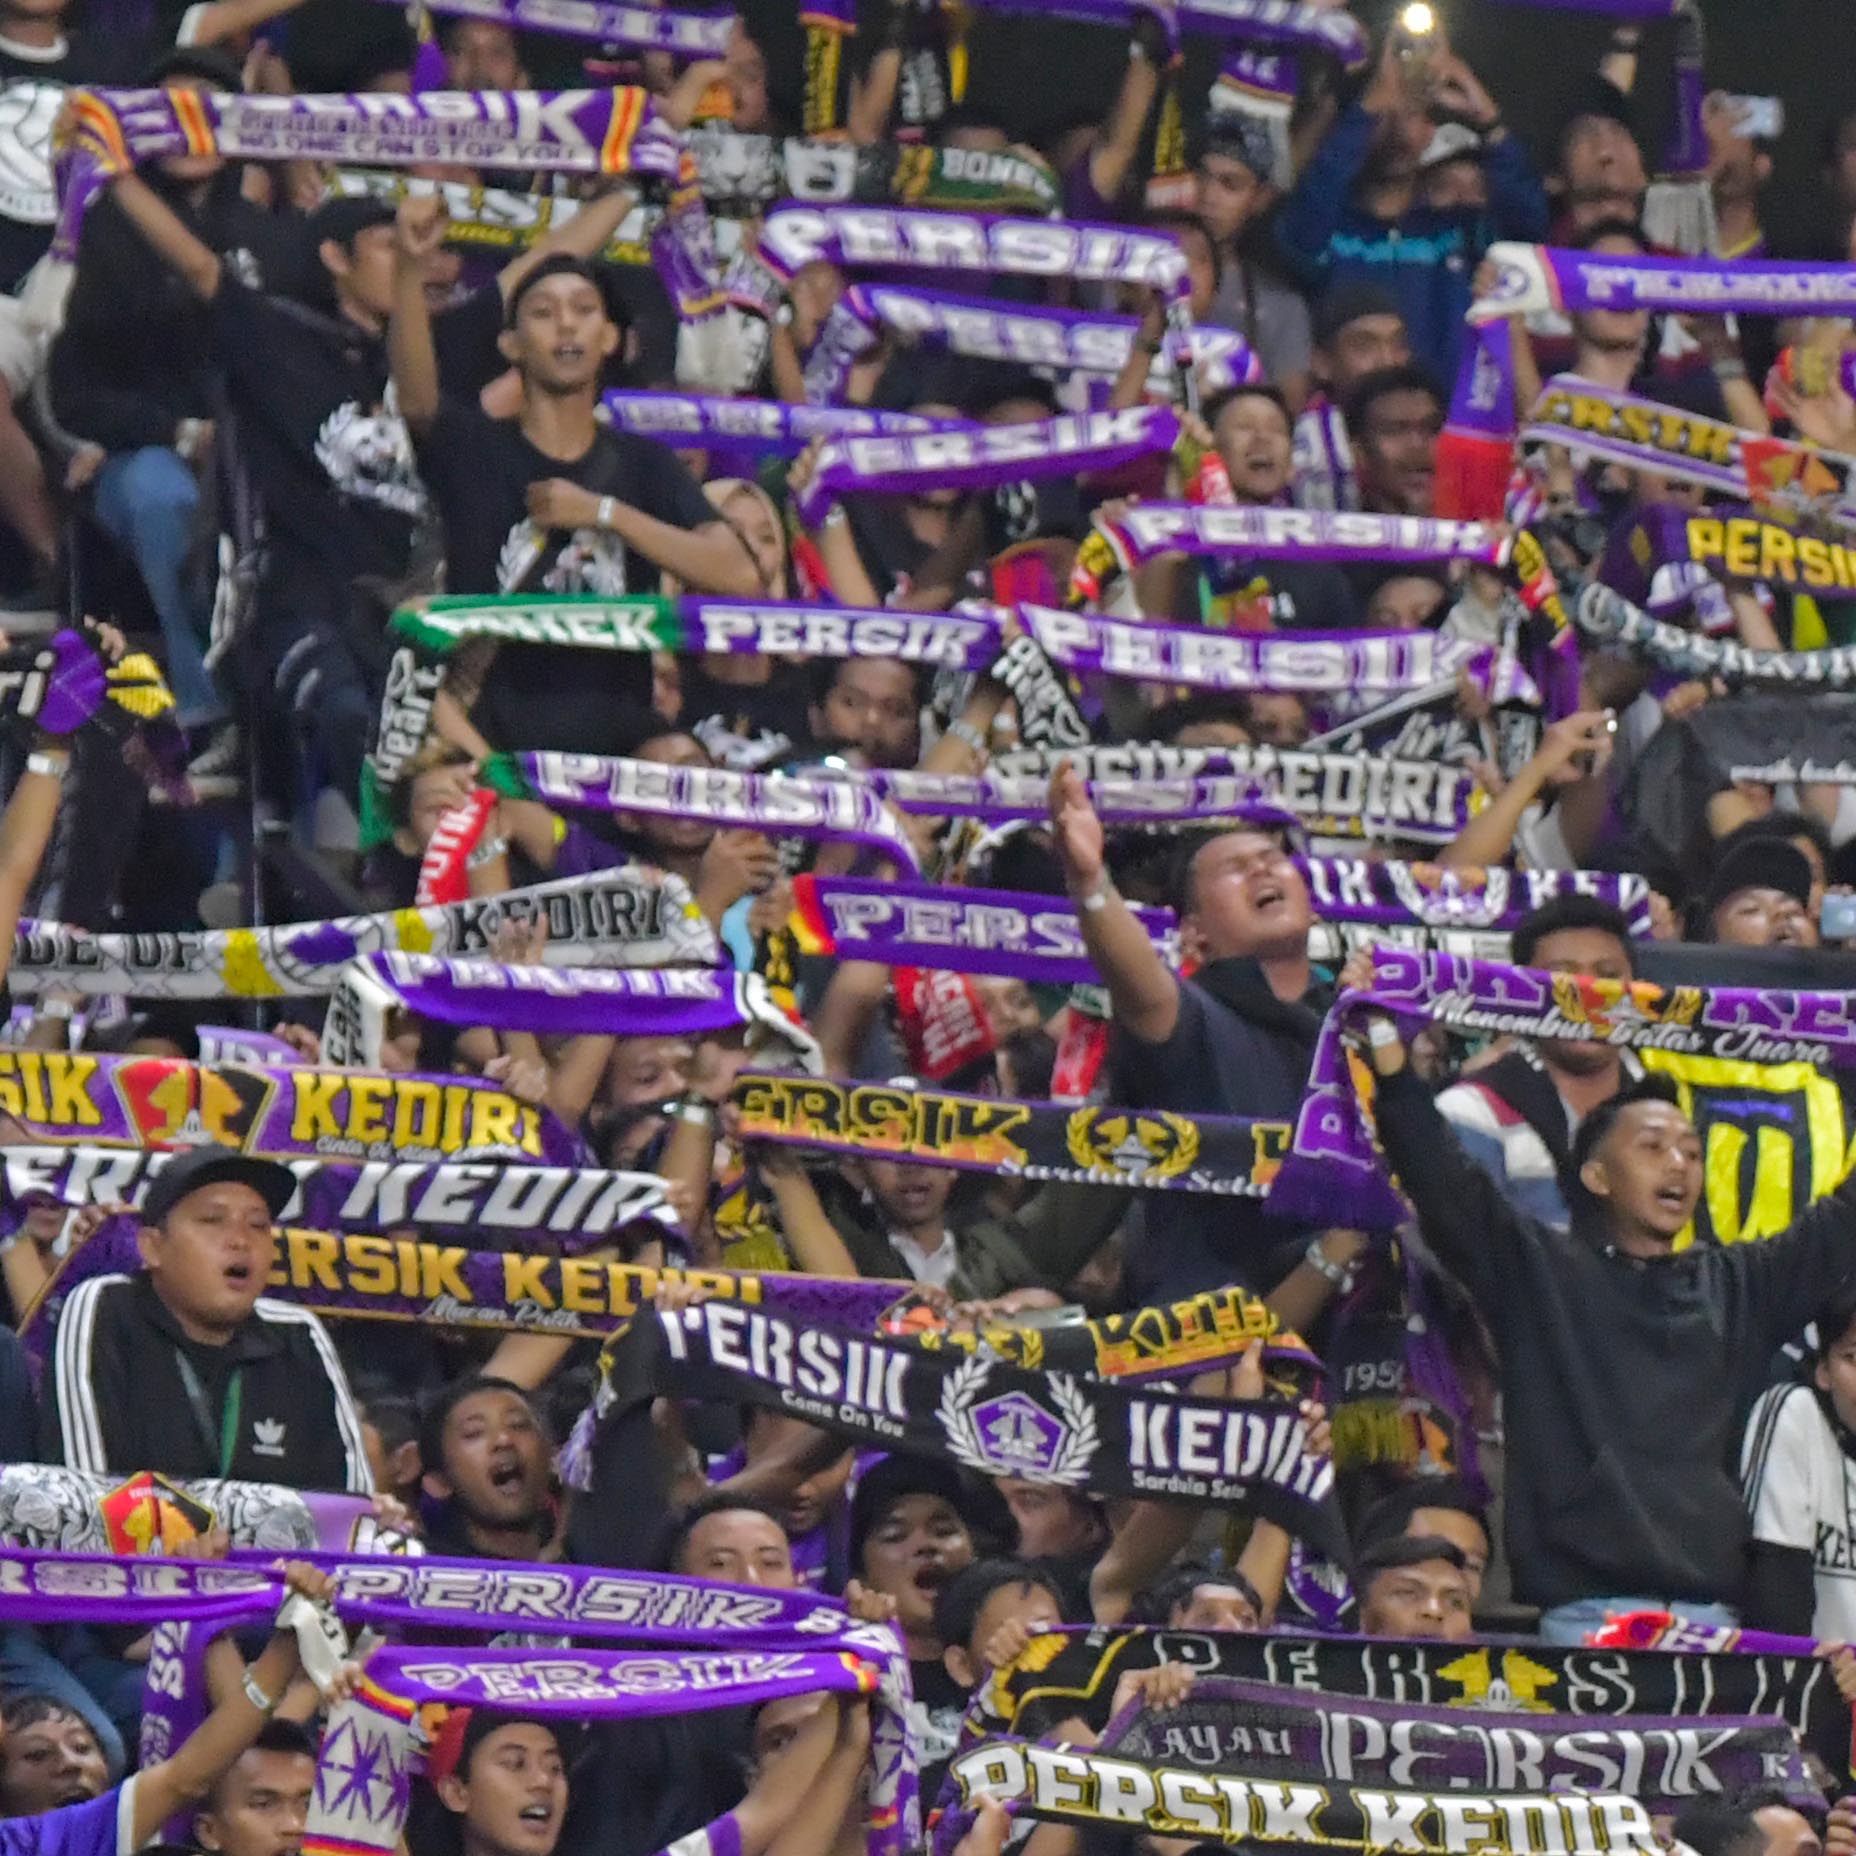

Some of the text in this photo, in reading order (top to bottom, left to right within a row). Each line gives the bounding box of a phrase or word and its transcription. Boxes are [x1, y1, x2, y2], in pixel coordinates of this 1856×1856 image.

[762, 209, 1182, 281] PERSIK
[1148, 508, 1490, 553] PERSIK
[701, 608, 985, 665] PERSIK
[1025, 606, 1494, 686] PERSIK
[1234, 750, 1470, 828] KEDIRI
[452, 883, 664, 953] KEDIRI
[388, 953, 722, 998] PERSIK
[1718, 1016, 1830, 1061] Juara
[295, 1073, 540, 1155] KEDIRI
[743, 1077, 1030, 1165] ERSIK
[267, 1229, 471, 1296] ERSIK
[659, 1307, 911, 1419] PERSIK
[781, 1389, 904, 1437] Come On You
[1134, 1472, 1206, 1498] Sardula
[334, 1563, 783, 1630] PERSIK
[955, 1747, 1330, 1840] PERSIK
